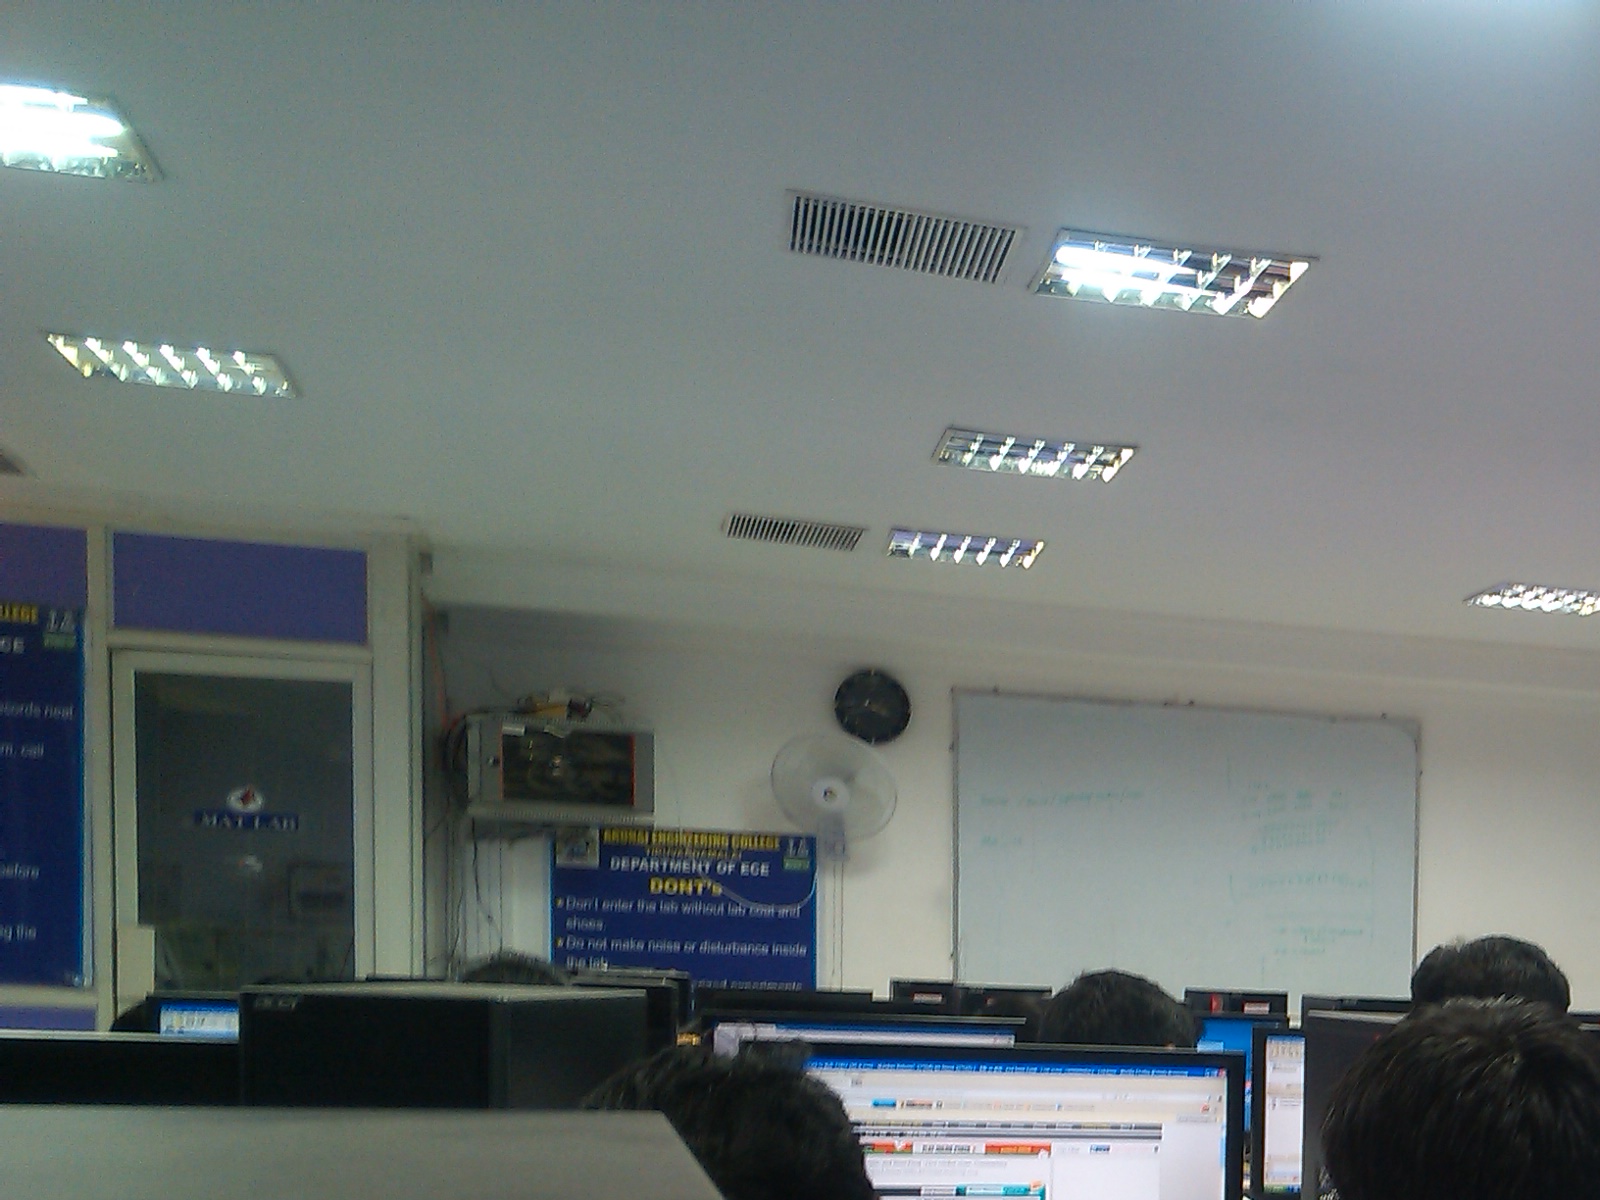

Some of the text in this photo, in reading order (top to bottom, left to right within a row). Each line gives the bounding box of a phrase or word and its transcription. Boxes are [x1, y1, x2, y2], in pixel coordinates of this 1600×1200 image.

[652, 829, 729, 849] ENGINEERING
[731, 833, 780, 851] COLLEGE
[610, 856, 710, 875] DEPARTMENT
[716, 859, 735, 876] OF
[602, 897, 633, 913] enter
[637, 898, 657, 913] the
[660, 898, 679, 914] lab
[681, 899, 724, 917] without
[727, 901, 746, 917] lab
[610, 937, 645, 953] make
[647, 939, 681, 954] noise
[700, 939, 769, 956] disturbance
[772, 941, 808, 957] inside
